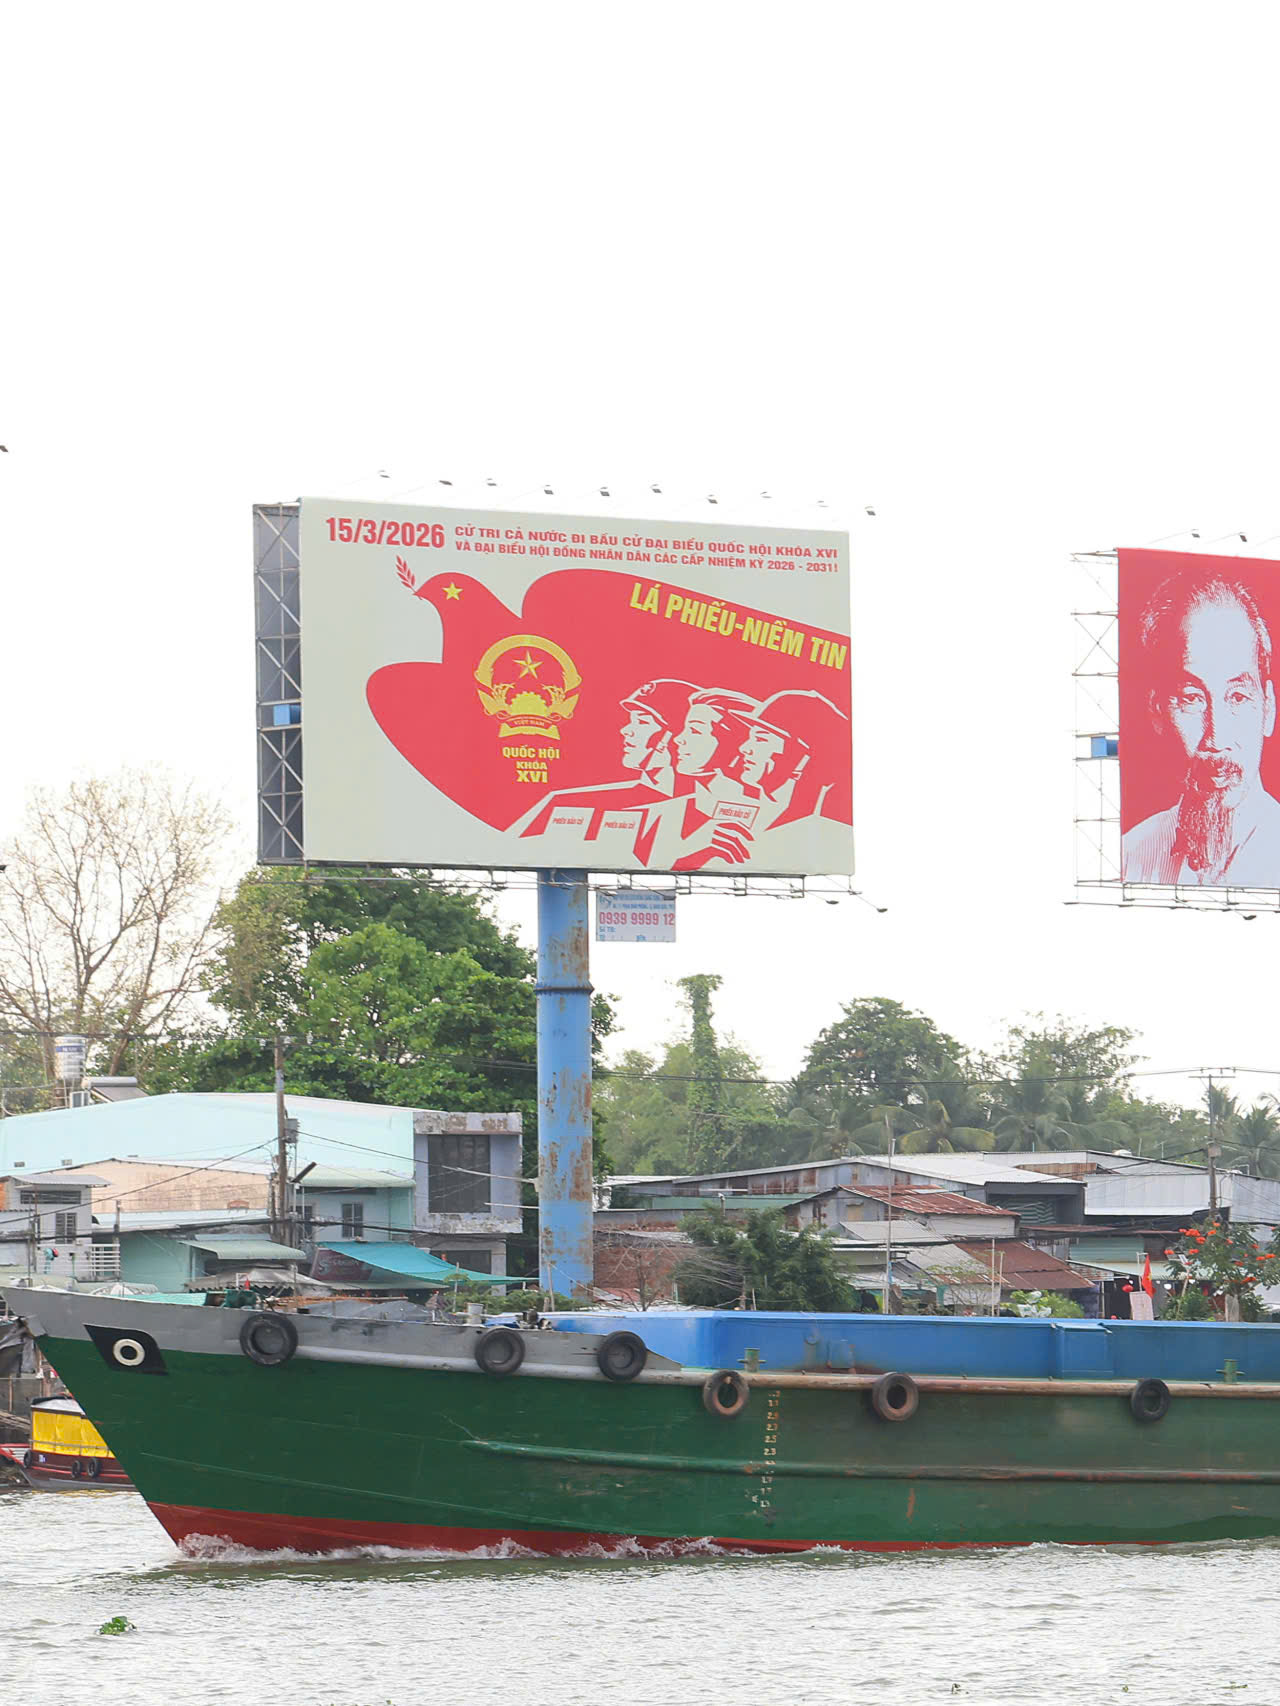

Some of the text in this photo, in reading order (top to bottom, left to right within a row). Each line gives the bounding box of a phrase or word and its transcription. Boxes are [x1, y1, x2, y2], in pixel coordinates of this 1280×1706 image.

[326, 517, 445, 548] 15/3/2026
[455, 523, 476, 537] CỬ
[479, 528, 500, 539] TRI
[505, 526, 524, 540] CẢ
[529, 529, 567, 543] NƯỚC
[571, 533, 586, 544] ĐI
[622, 534, 643, 548] CỬ
[645, 539, 669, 552] ĐẠI
[708, 540, 745, 555] QUỐC
[749, 544, 772, 558] HỘI
[776, 546, 812, 558] KHÓA
[816, 548, 838, 559] XVI
[455, 539, 472, 551] VÀ
[474, 543, 495, 555] ĐẠI
[530, 544, 551, 558] HỘI
[553, 545, 586, 559] ĐỒNG
[590, 548, 623, 561] NHÂN
[627, 550, 651, 563] DÂN
[654, 551, 678, 564] CÁC
[681, 552, 705, 566] CẤP
[708, 556, 746, 570] NHIỆM
[749, 557, 764, 570] KỲ
[767, 560, 795, 571] 2026
[806, 562, 838, 573] 2031!
[630, 583, 662, 615] LÁ
[810, 636, 848, 671] TIN
[502, 744, 560, 761] QUỐC HỘI
[516, 770, 548, 783] XVI
[599, 911, 675, 926] 0939 9999 12
